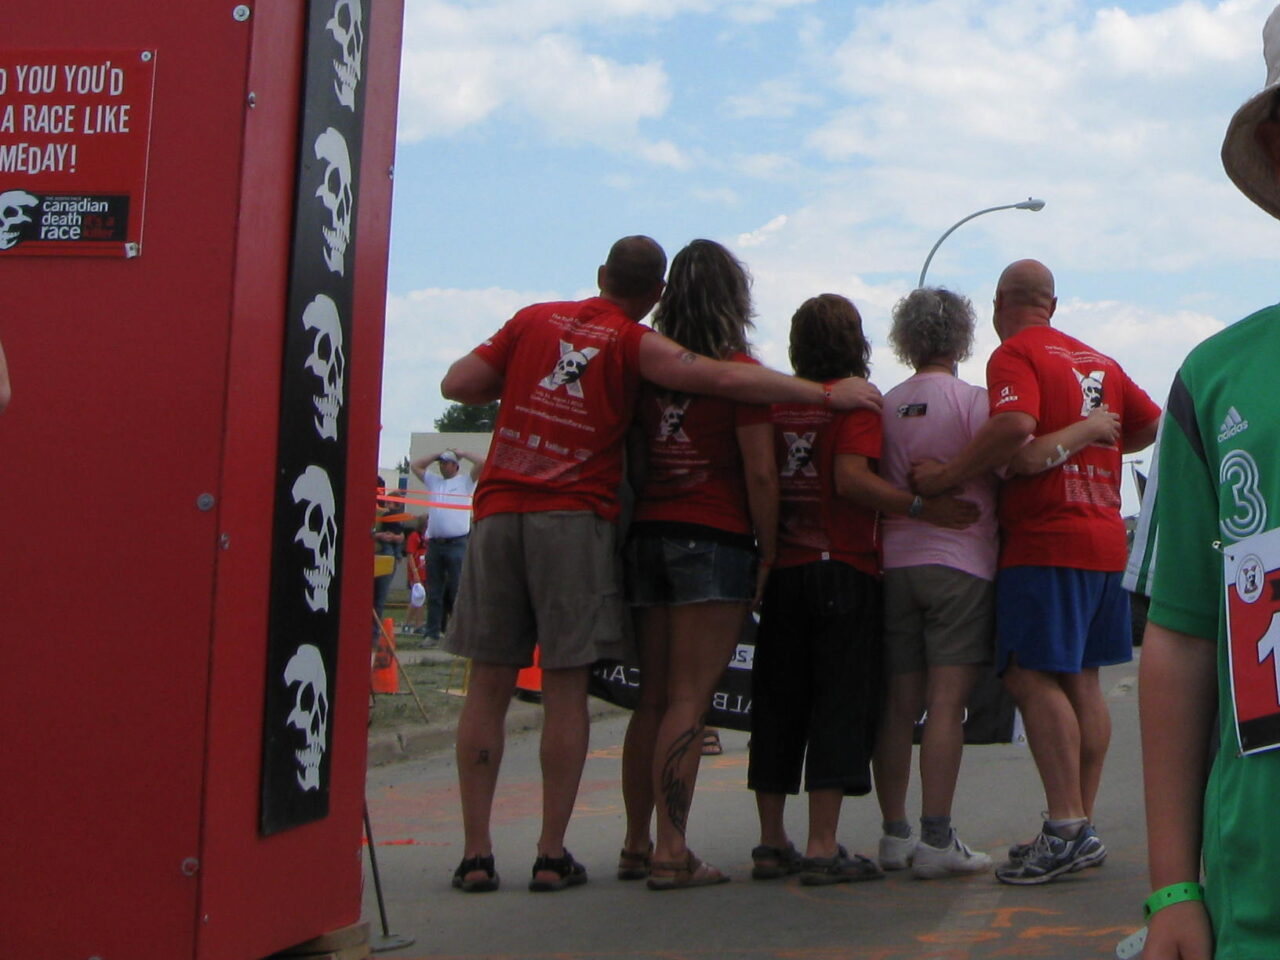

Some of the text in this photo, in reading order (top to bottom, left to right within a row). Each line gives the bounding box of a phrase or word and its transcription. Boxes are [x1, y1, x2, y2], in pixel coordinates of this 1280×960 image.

[16, 65, 57, 94] YOU
[65, 61, 124, 96] YOU'D
[1, 104, 131, 134] A RACE LIKE
[43, 197, 109, 213] canadian
[41, 212, 82, 226] death
[40, 225, 81, 239] race
[1217, 420, 1249, 443] adidas
[1219, 449, 1268, 540] 3
